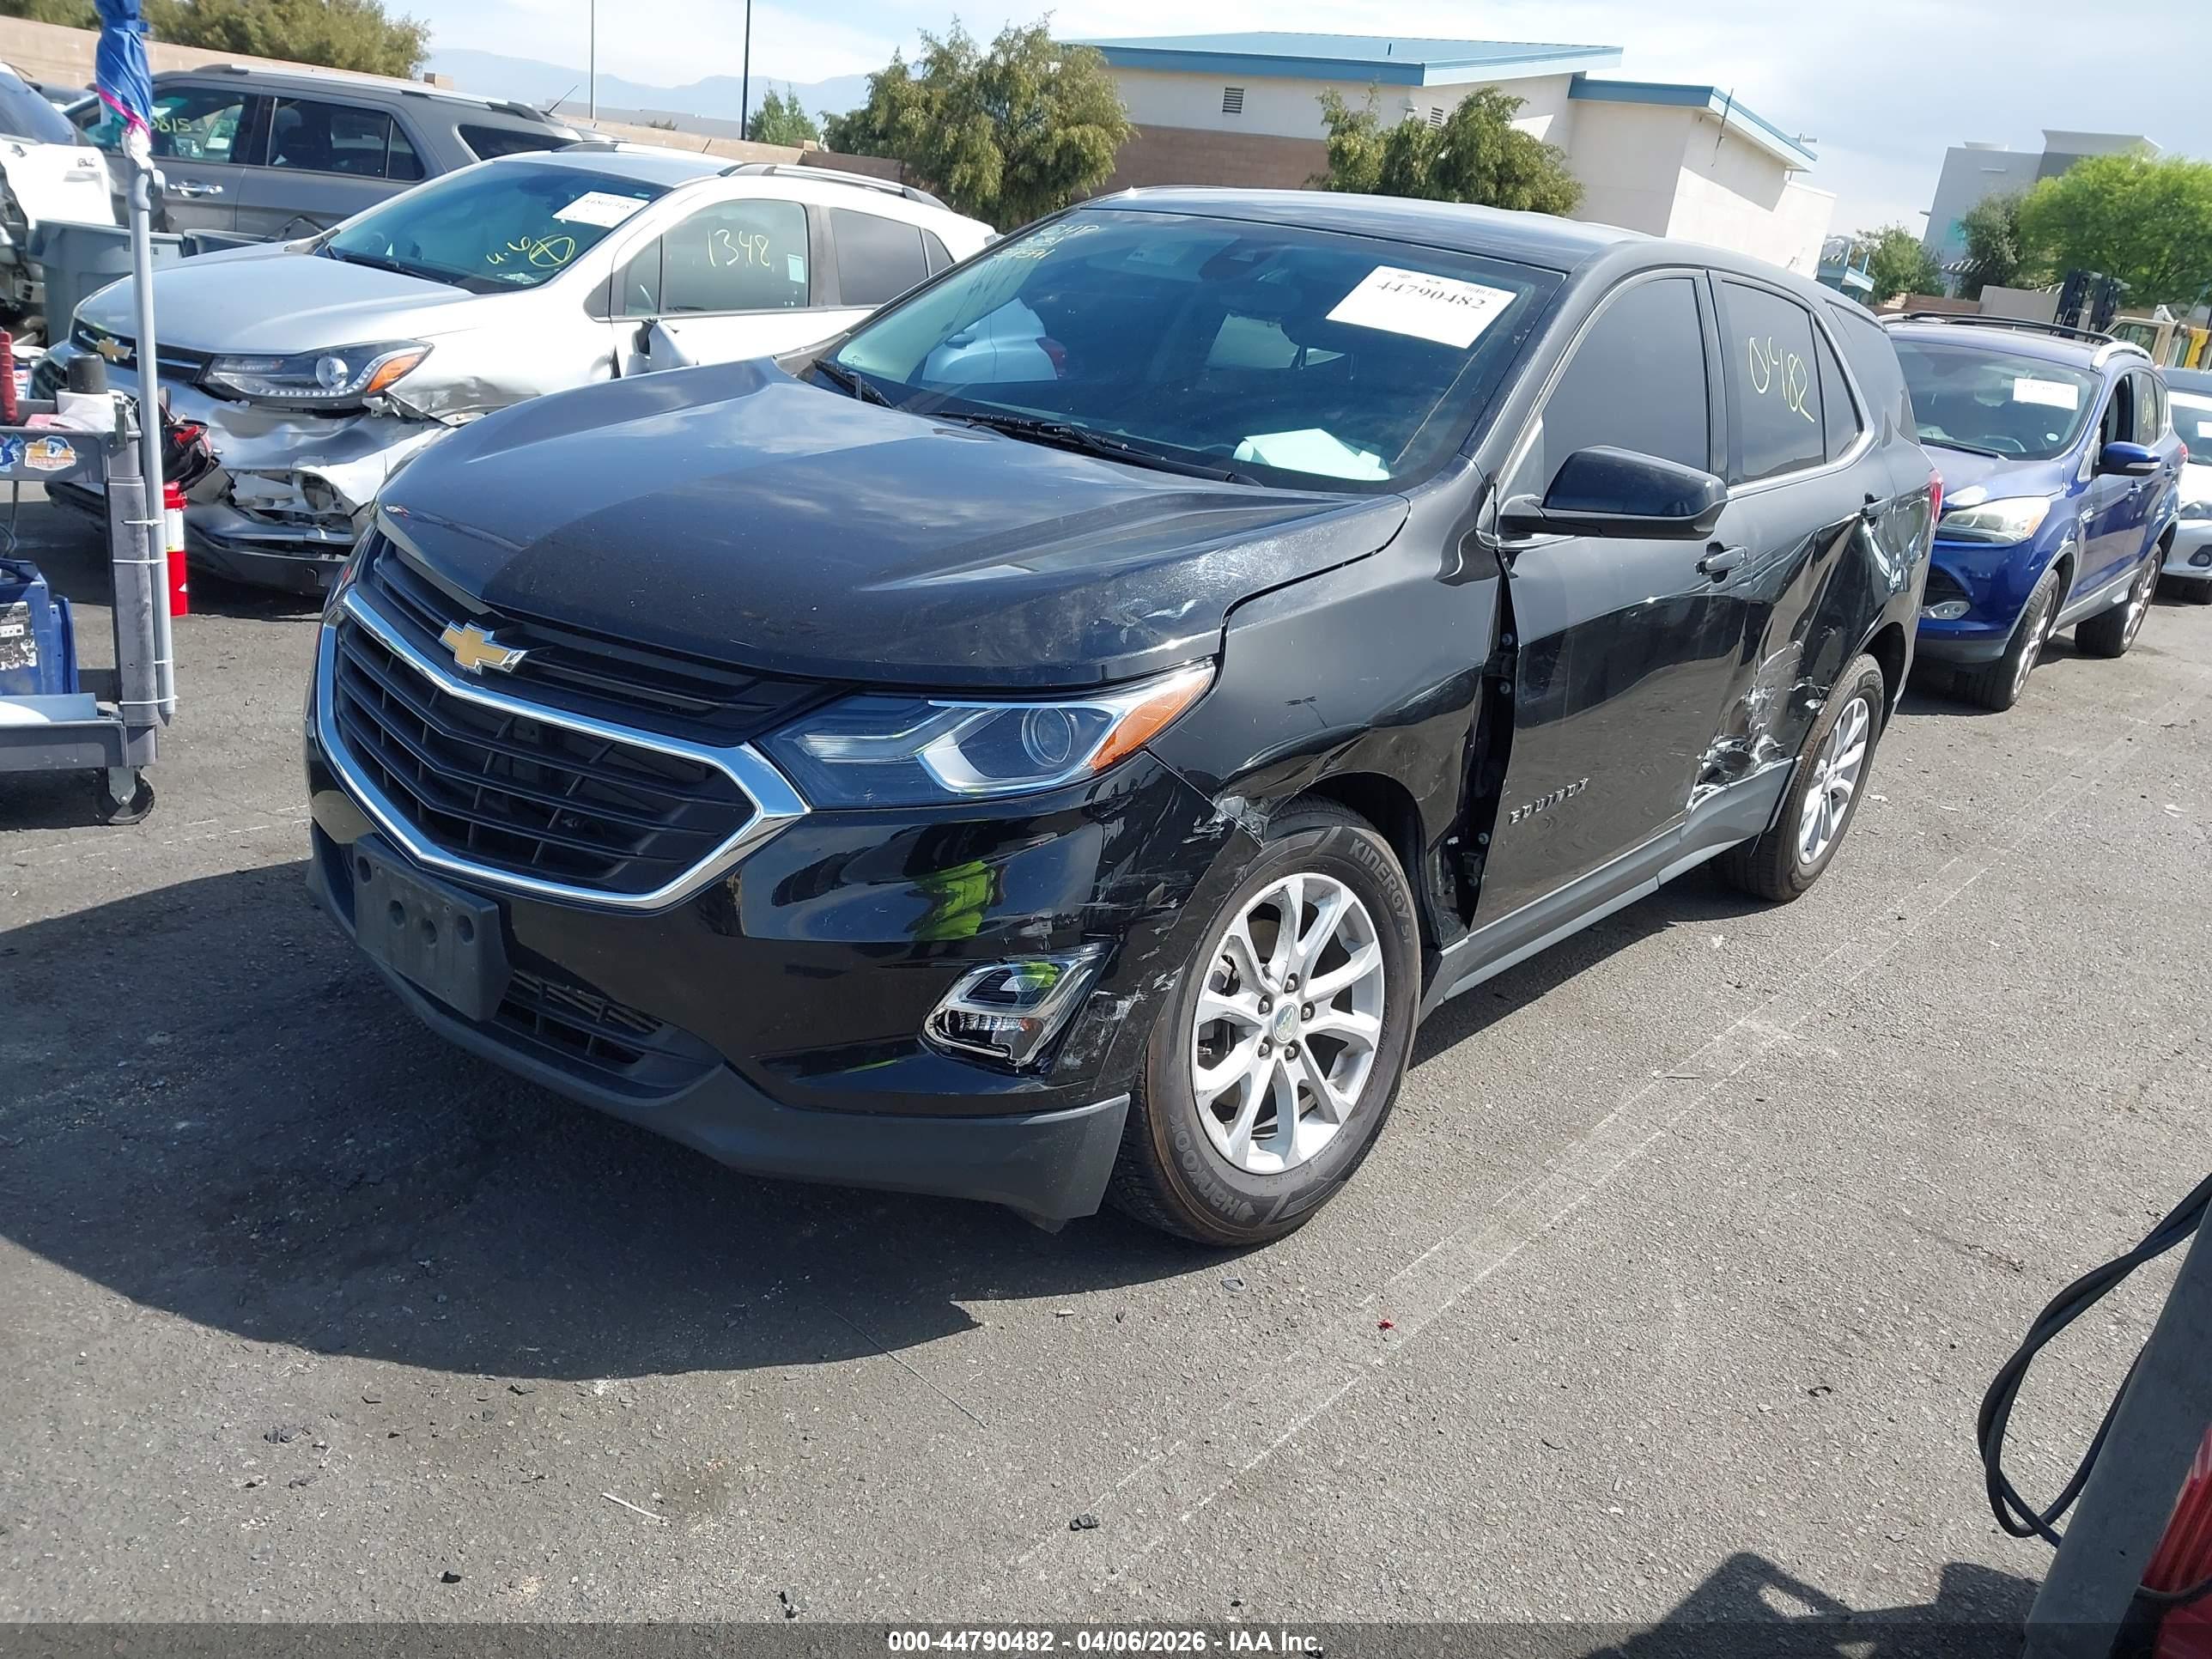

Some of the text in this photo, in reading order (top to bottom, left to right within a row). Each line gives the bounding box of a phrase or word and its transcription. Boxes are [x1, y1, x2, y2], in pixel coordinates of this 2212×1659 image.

[707, 228, 770, 268] 1348
[1376, 281, 1486, 309] 44790482
[1748, 336, 1816, 423] 0482
[1509, 777, 1589, 824] EQUINOX
